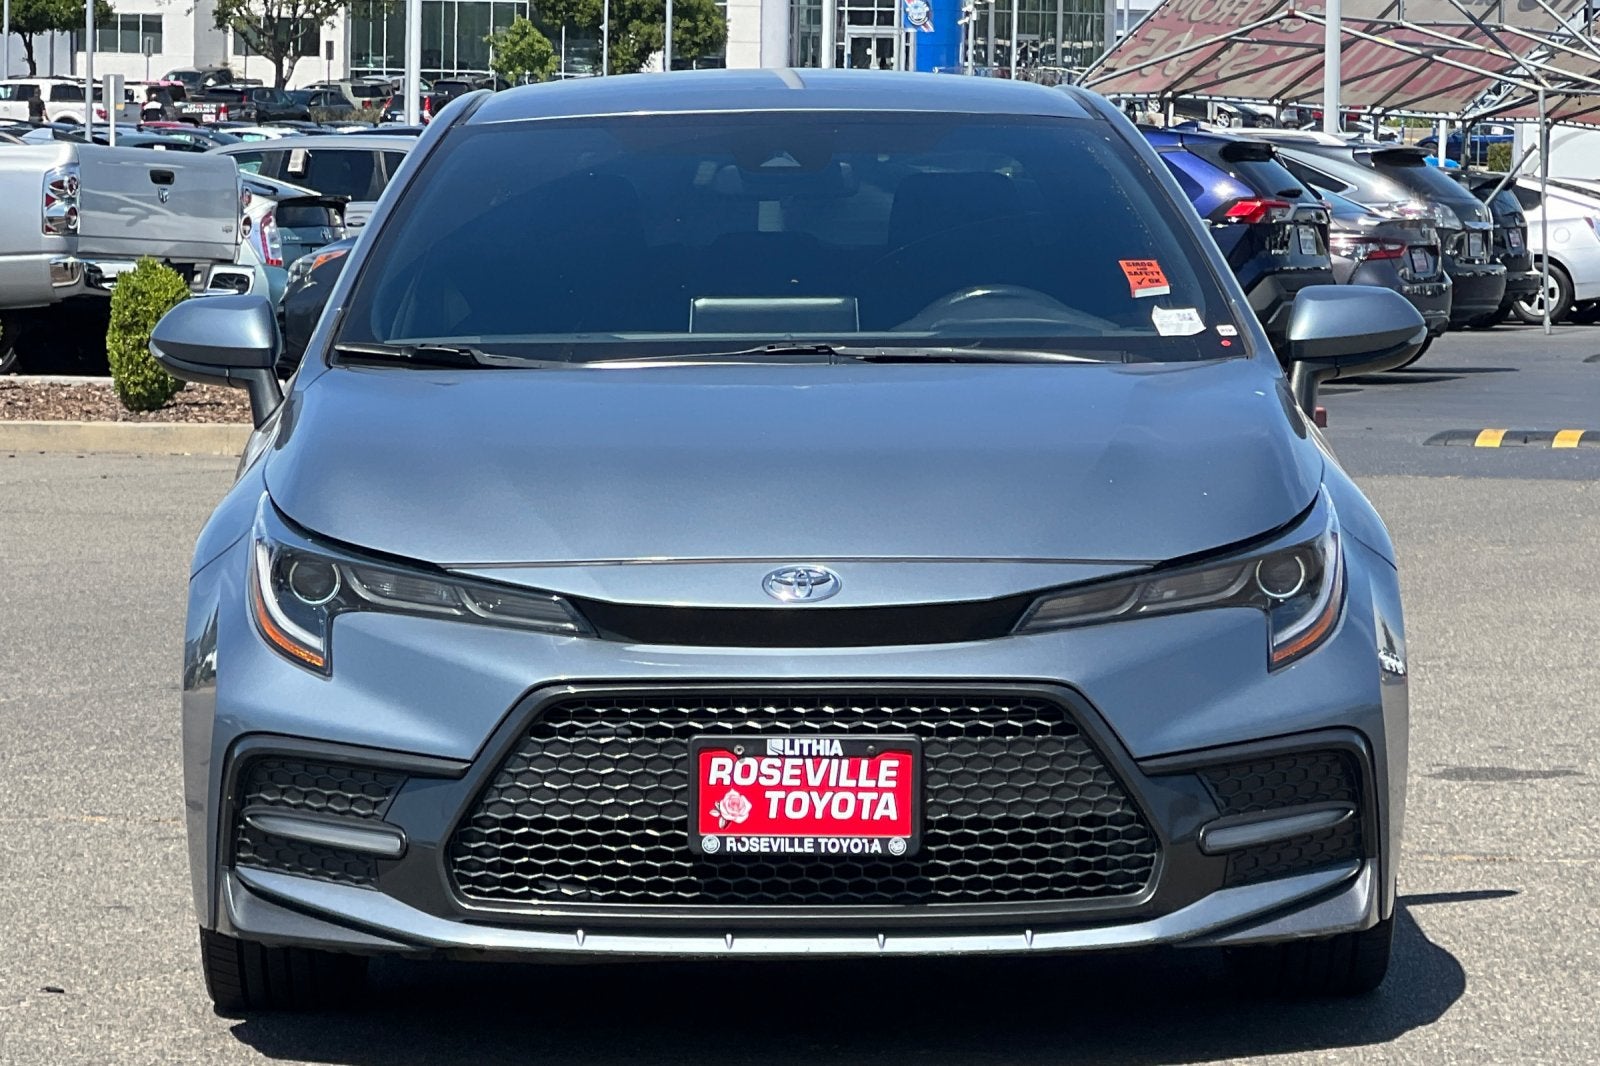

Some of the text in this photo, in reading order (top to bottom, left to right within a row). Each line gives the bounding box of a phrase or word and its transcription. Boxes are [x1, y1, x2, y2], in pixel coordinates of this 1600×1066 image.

[784, 739, 843, 756] LITHIA
[708, 757, 900, 788] ROSEVILLE
[764, 790, 898, 821] TOYOTA
[726, 837, 882, 854] ROSEVILLE TOYOTA
